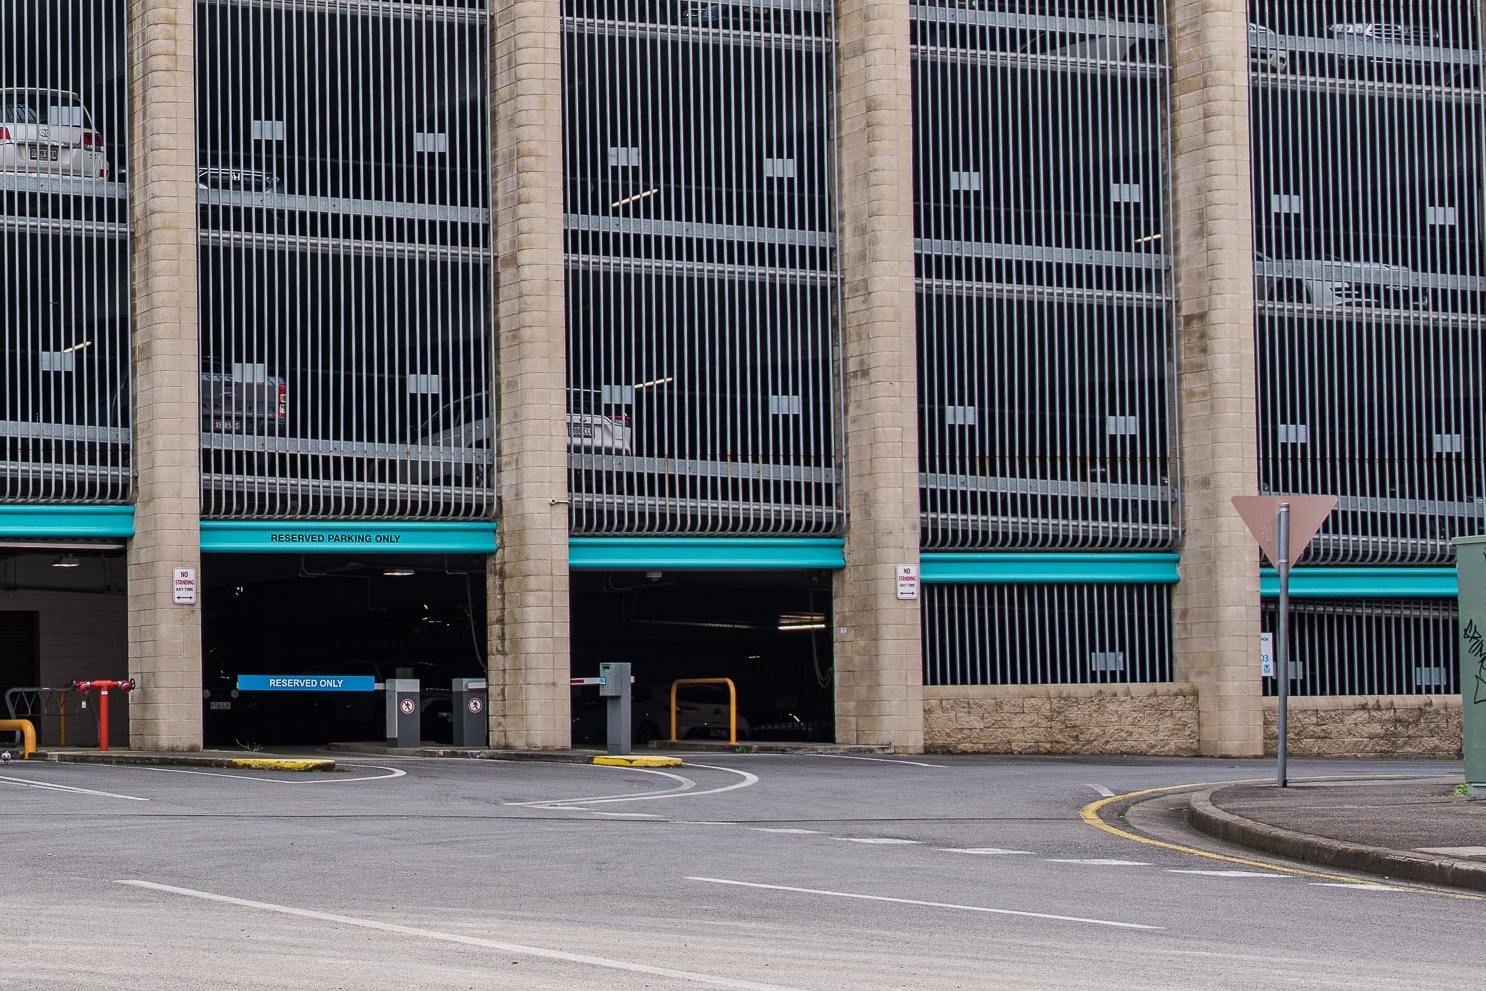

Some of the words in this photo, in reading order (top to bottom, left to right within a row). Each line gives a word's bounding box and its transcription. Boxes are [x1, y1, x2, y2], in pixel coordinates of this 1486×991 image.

[270, 534, 325, 543] RESERVED
[327, 535, 372, 543] PARKING
[375, 535, 401, 543] ONLY
[269, 678, 318, 687] RESERVED
[319, 679, 344, 688] ONLY
